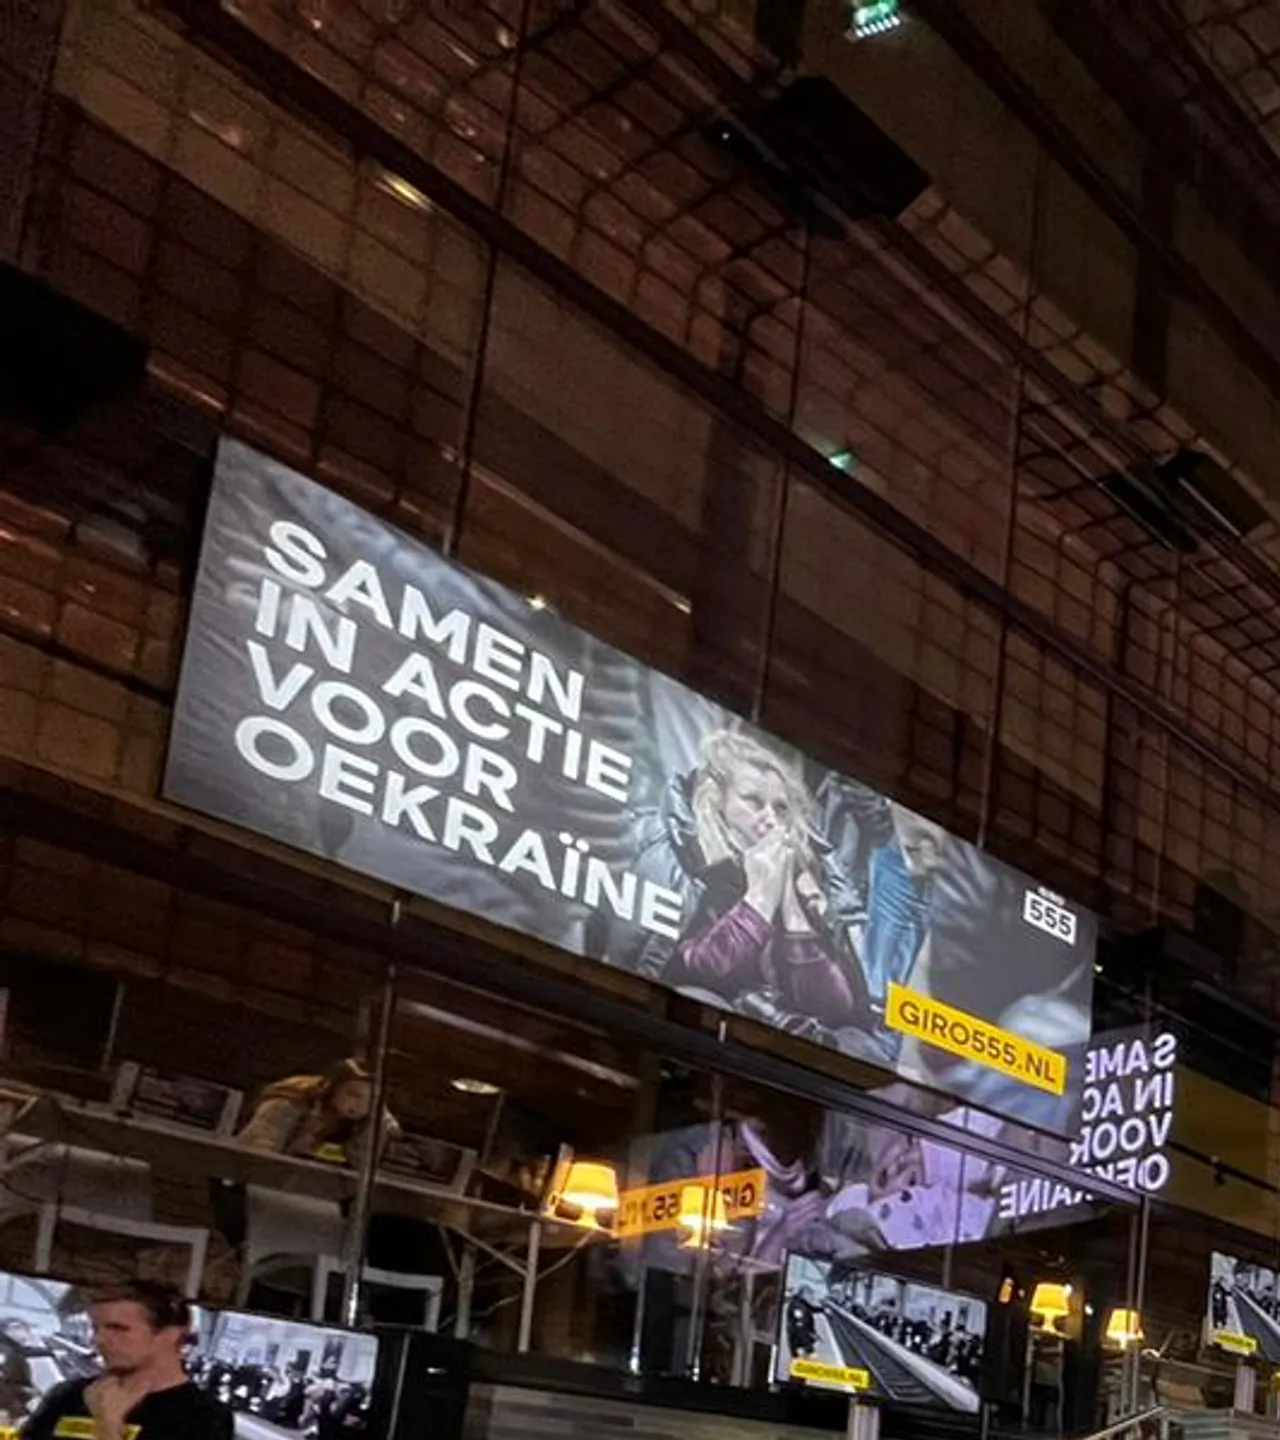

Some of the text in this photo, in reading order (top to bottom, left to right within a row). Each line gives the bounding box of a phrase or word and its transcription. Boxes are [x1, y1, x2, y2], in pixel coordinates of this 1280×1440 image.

[255, 577, 633, 803] IN ACTIE
[263, 521, 585, 722] SAMEN
[247, 640, 518, 813] VOOR
[235, 716, 686, 940] OEKRAÏNE
[1029, 898, 1073, 937] 555
[899, 1000, 1057, 1084] GIRO555.NL
